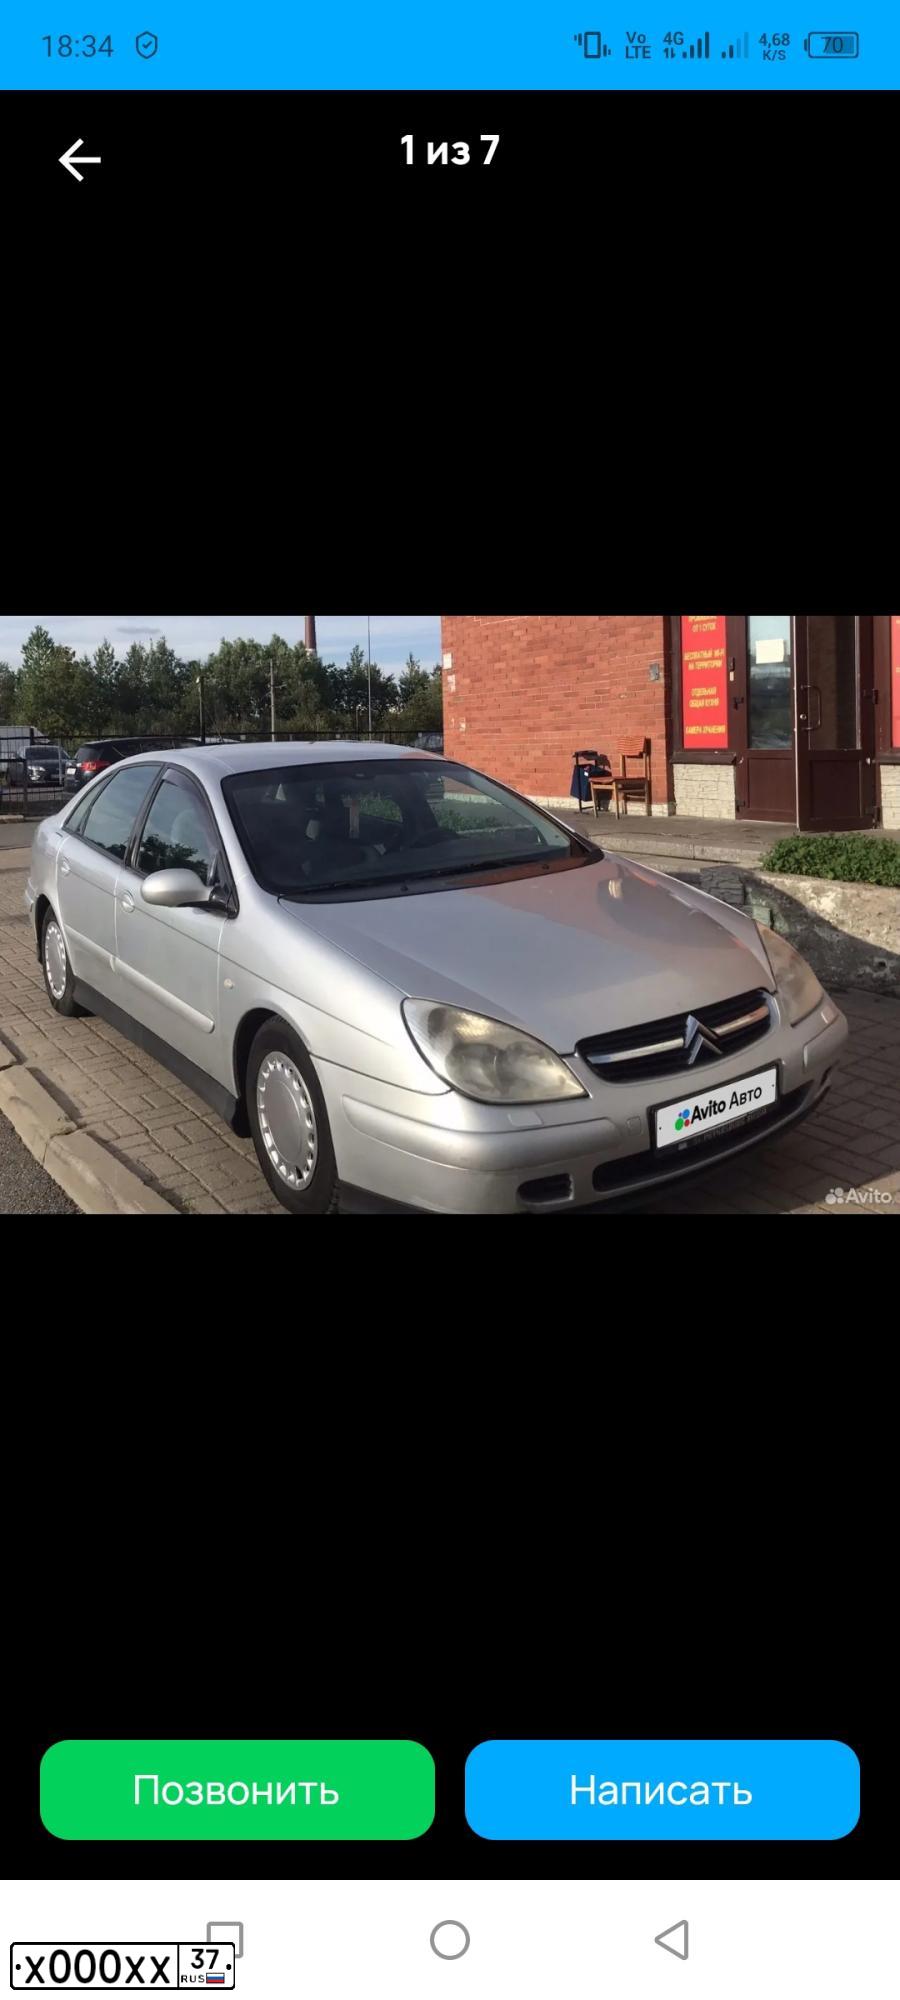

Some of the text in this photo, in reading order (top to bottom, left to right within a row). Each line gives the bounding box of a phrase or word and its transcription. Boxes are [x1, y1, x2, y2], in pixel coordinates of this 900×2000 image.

[42, 33, 114, 59] 18:34
[625, 31, 647, 44] Vo
[662, 31, 685, 45] 4G
[758, 32, 791, 48] 4,68
[821, 36, 844, 54] 70
[625, 45, 651, 60] LTE
[762, 49, 787, 61] K/S
[400, 134, 501, 166] 1 из 7
[134, 1774, 340, 1806] Позвонить
[571, 1774, 753, 1806] Написать
